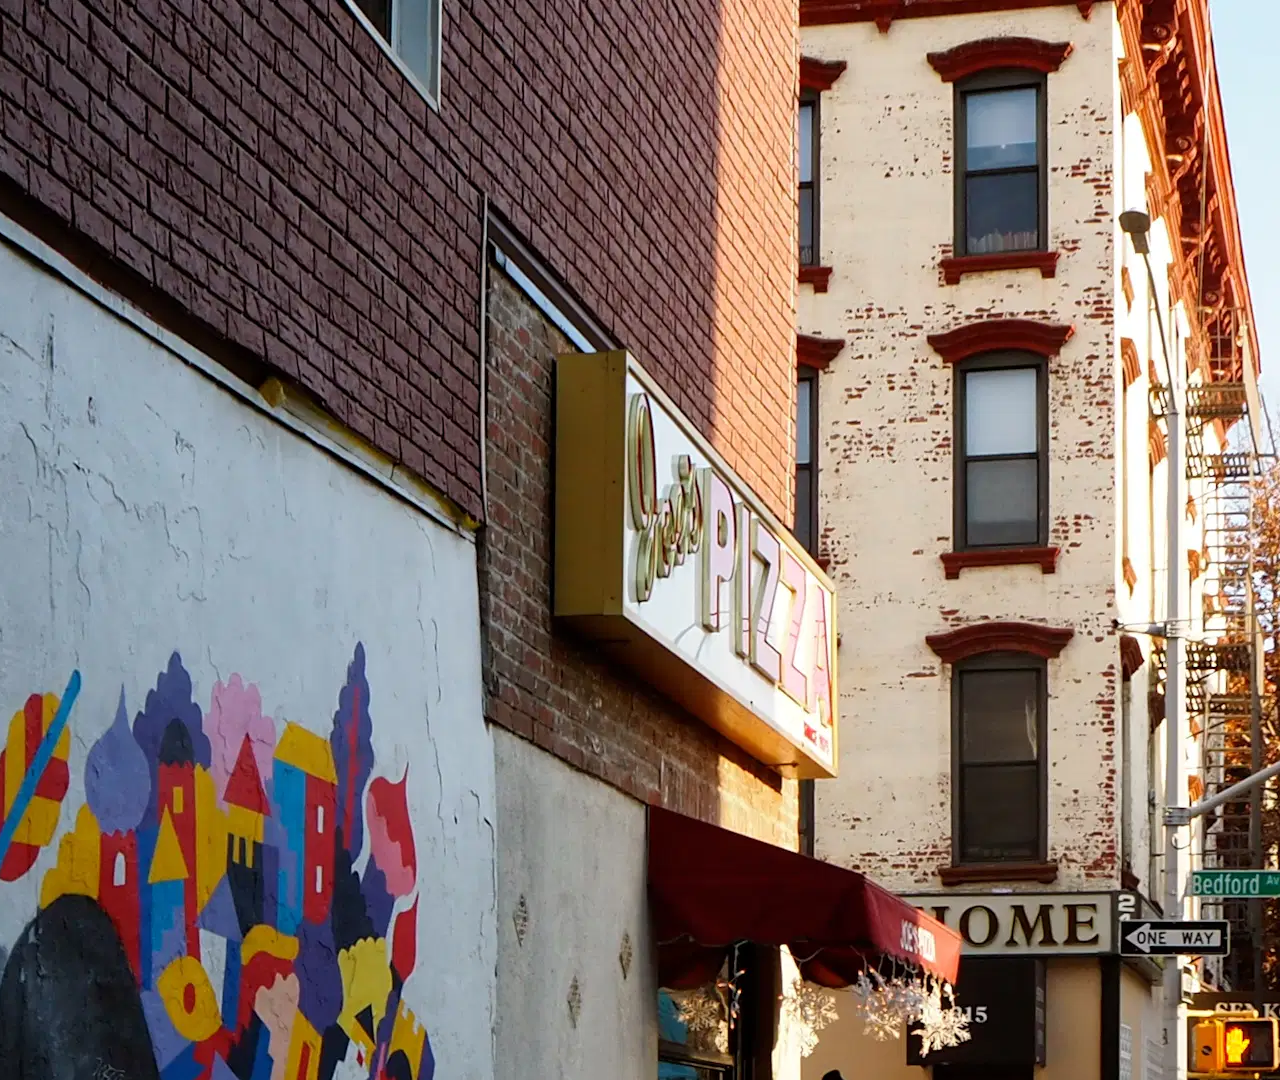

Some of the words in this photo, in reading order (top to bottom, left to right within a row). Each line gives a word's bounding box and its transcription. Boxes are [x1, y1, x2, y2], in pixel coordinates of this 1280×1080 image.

[697, 465, 833, 728] PIZZA
[1192, 873, 1261, 895] Bedford
[1266, 877, 1280, 886] Av
[1137, 931, 1167, 945] ONE
[1182, 931, 1214, 945] WAY
